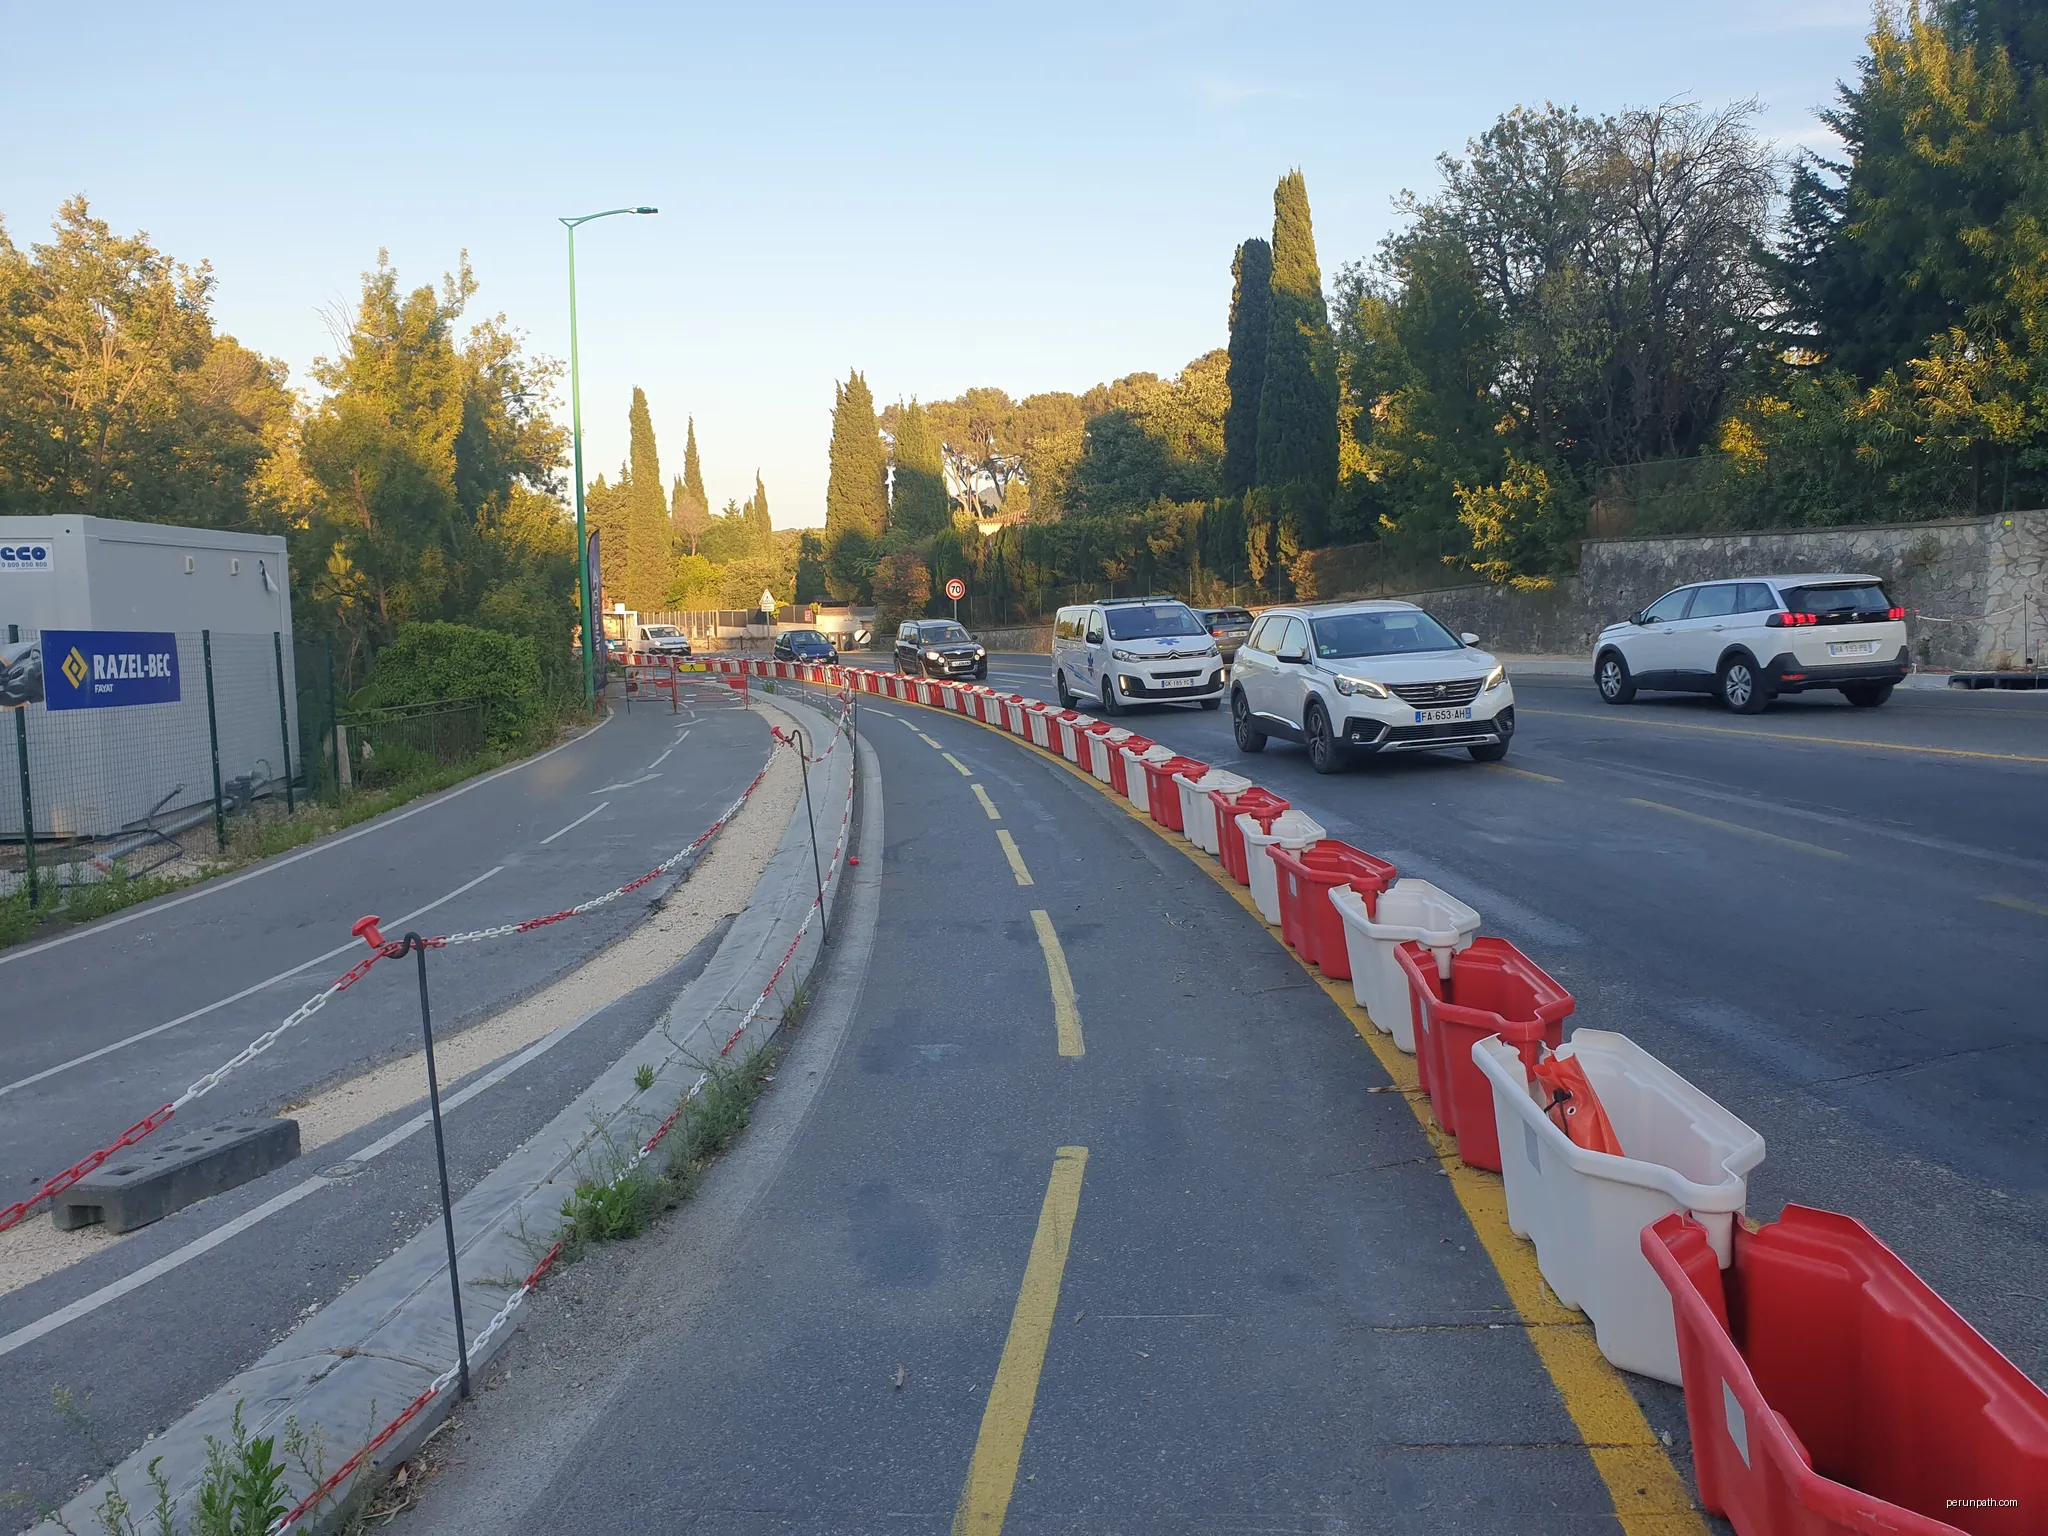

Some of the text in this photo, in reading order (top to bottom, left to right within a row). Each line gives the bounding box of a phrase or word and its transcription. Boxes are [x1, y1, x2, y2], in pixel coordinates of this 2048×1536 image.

[951, 585, 961, 594] 70
[93, 653, 171, 680] RAZEL-BEC
[94, 684, 114, 694] FAYAT
